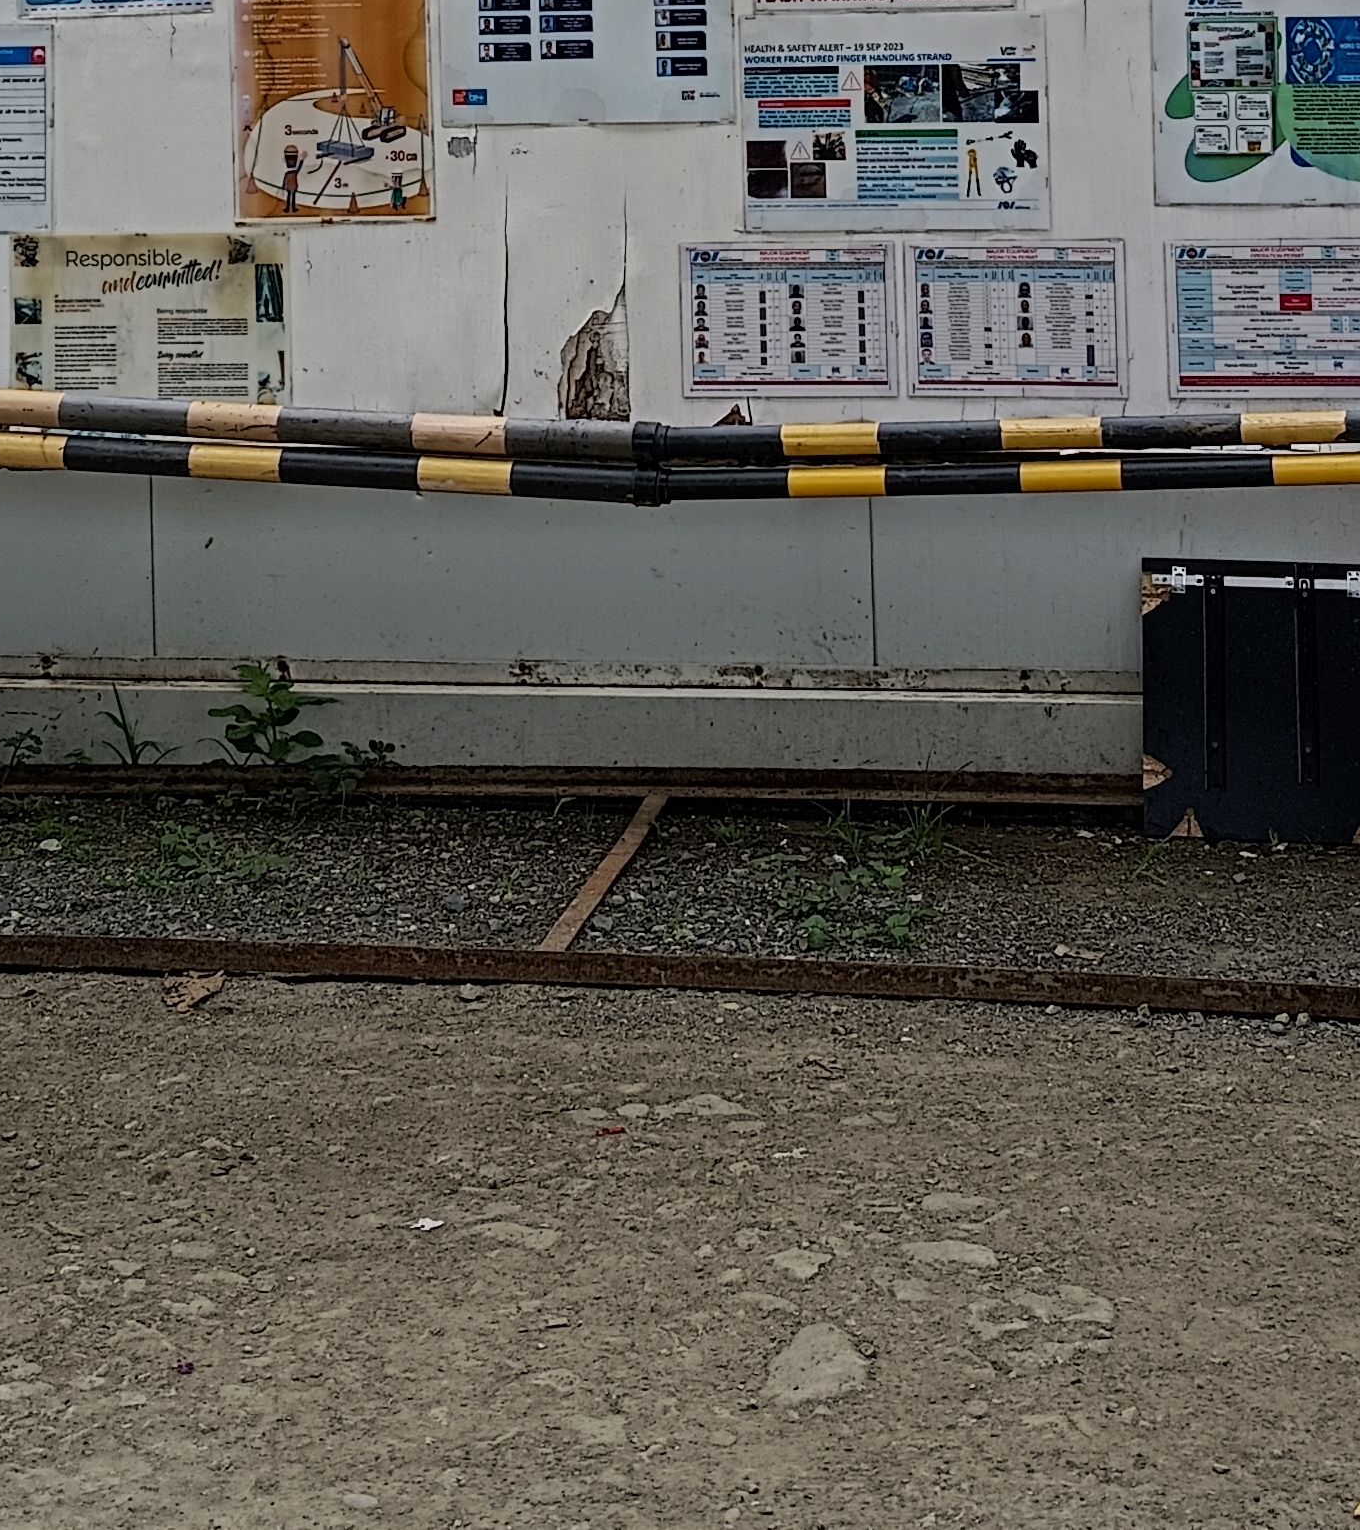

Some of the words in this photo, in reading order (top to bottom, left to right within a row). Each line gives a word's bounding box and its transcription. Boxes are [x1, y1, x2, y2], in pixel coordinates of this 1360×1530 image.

[744, 45, 776, 53] HEALTH
[786, 44, 817, 52] SAFETY
[818, 43, 845, 51] ALERT
[853, 43, 864, 51] 19
[866, 43, 881, 51] SEP
[883, 43, 904, 51] 2023
[744, 56, 782, 64] WORKER
[784, 55, 835, 64] FRACTURED
[836, 54, 868, 62] FINGER
[869, 54, 915, 62] HANDLING
[916, 53, 953, 61] STRAND
[65, 249, 183, 271] Responsible
[102, 271, 137, 296] and
[135, 258, 223, 291] committed!
